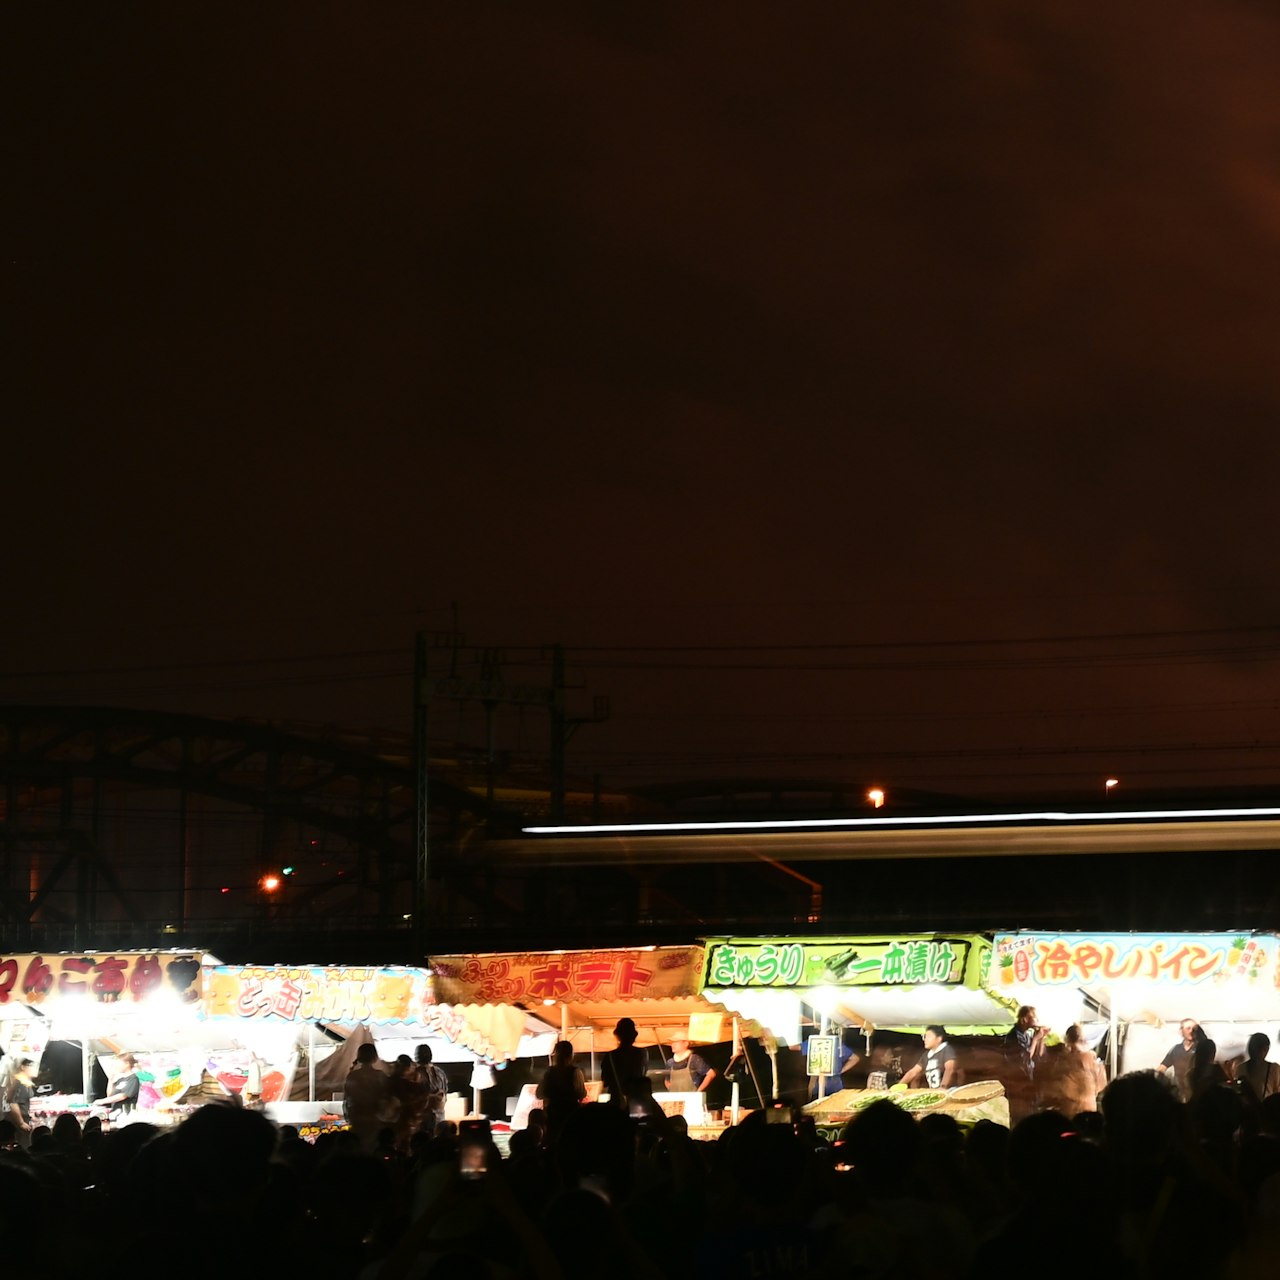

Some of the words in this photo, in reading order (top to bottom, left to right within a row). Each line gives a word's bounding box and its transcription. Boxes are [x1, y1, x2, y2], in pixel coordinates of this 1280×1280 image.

[714, 944, 803, 984] きゅうり
[850, 942, 956, 983] 一本漬け
[1036, 941, 1220, 980] 冷やしパイン
[525, 961, 652, 1000] ポテト
